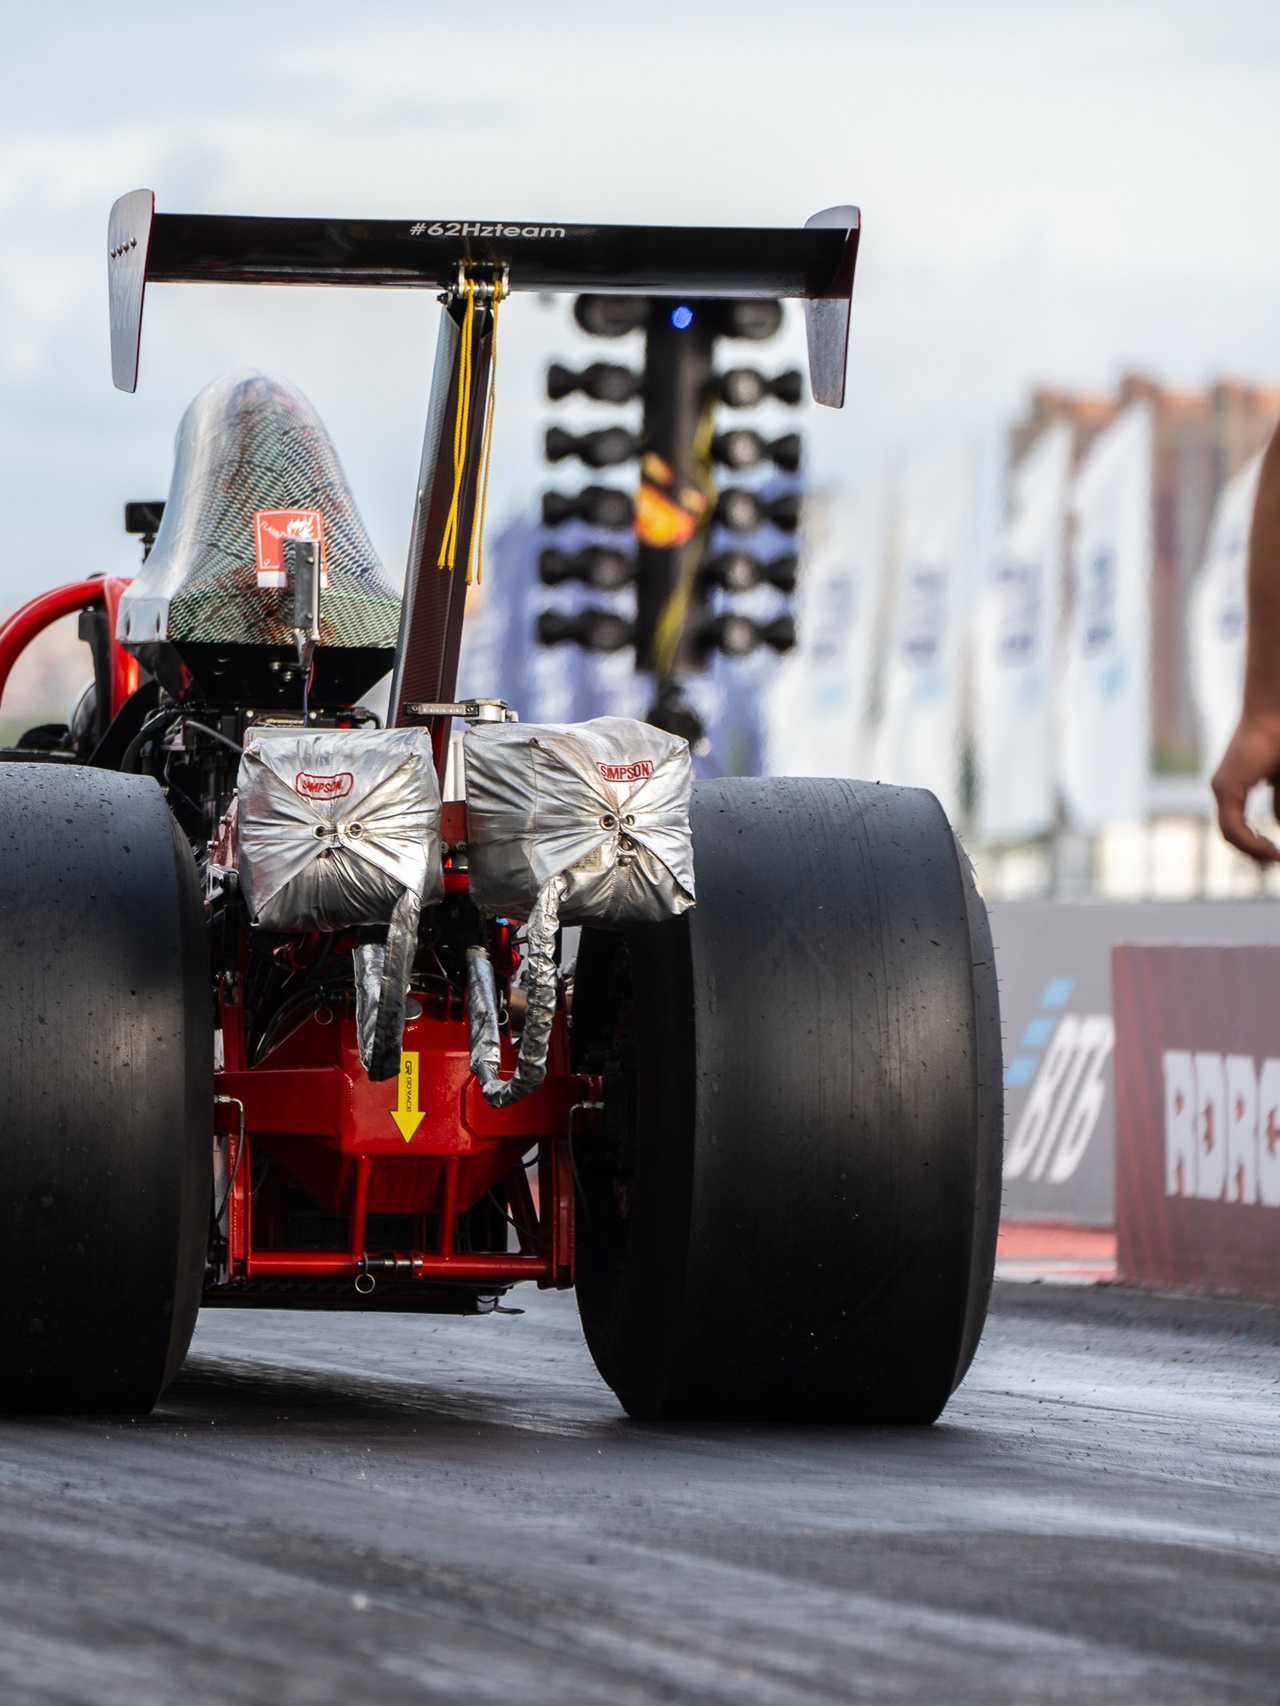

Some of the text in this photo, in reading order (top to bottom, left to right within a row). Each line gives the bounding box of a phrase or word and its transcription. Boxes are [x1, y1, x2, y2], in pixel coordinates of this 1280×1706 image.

[409, 222, 566, 238] #62Hzteam
[600, 763, 650, 780] SIMPSON
[302, 779, 343, 793] SIMPSON
